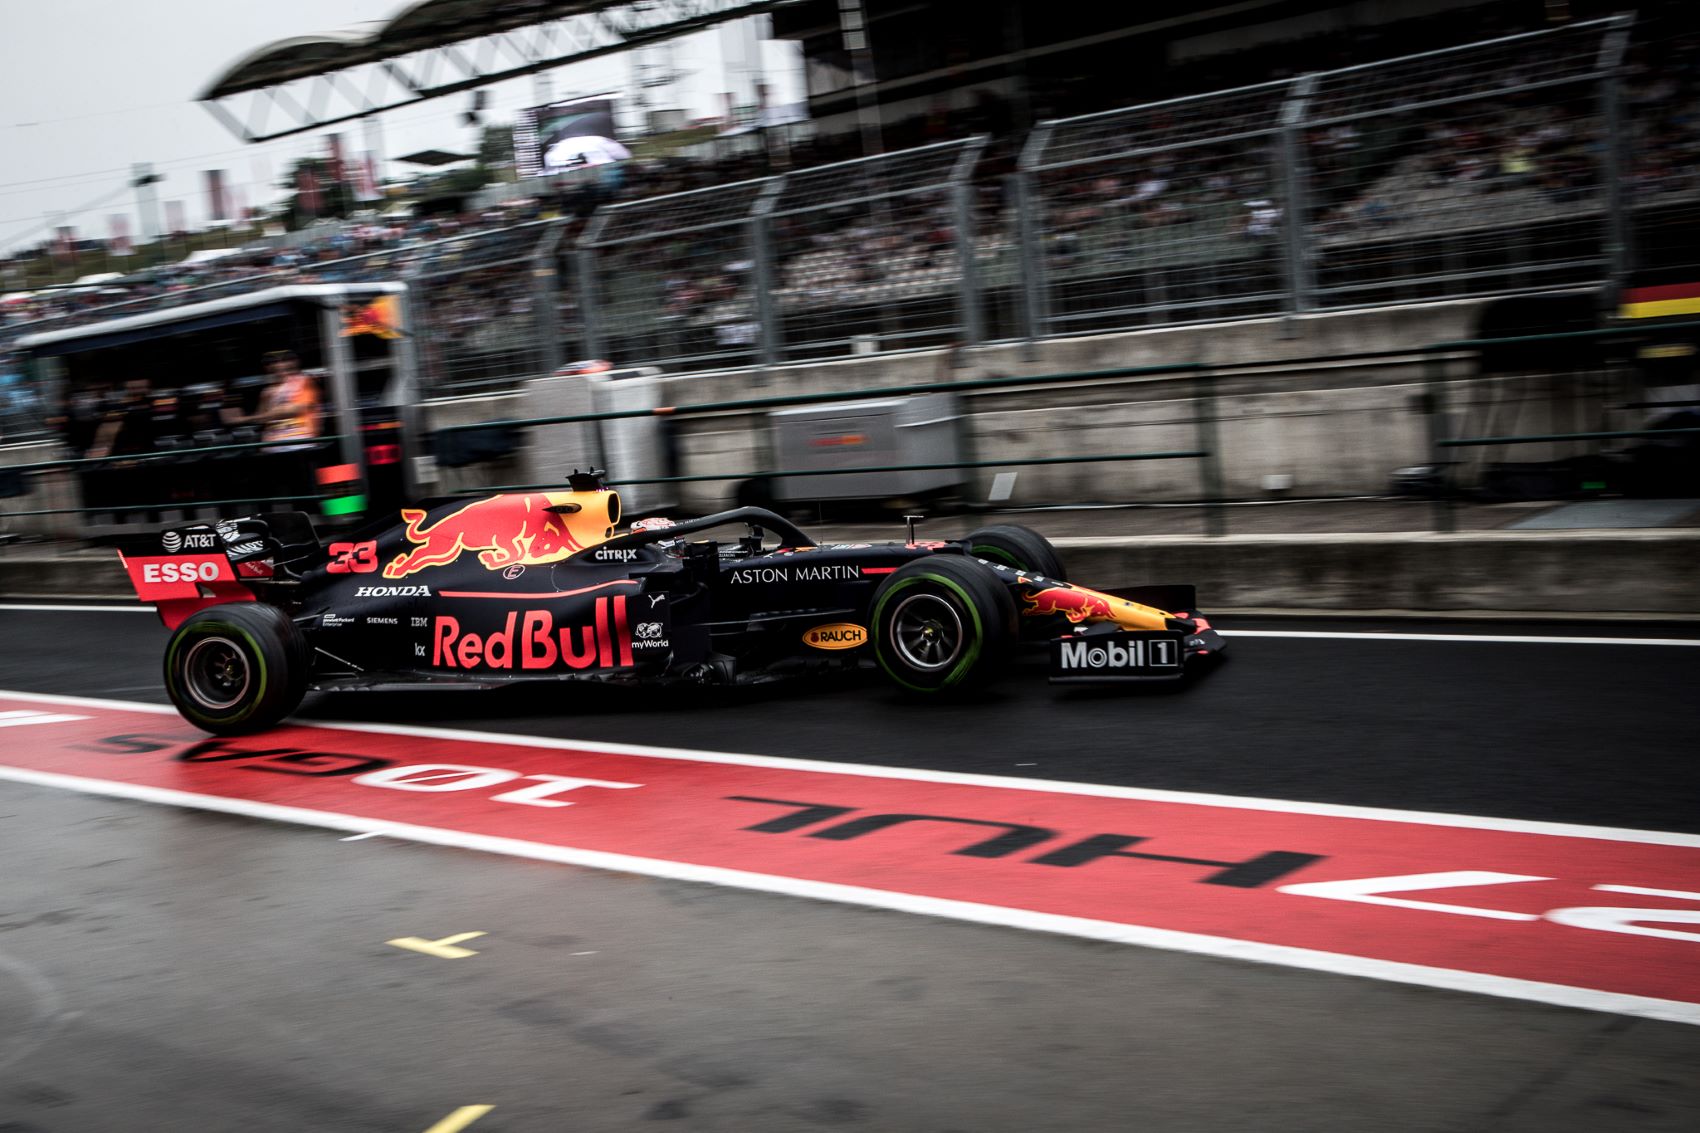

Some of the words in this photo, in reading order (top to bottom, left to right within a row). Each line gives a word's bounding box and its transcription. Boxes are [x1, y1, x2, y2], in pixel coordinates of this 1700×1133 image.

[183, 533, 217, 549] AT&T
[326, 540, 378, 573] 33
[143, 561, 219, 583] ESSO
[730, 568, 788, 584] ASTON
[795, 565, 860, 581] MARTIN
[354, 585, 432, 597] HONDA
[366, 617, 398, 625] SIEMENS
[410, 616, 429, 627] IBM
[432, 610, 517, 669] Red
[521, 595, 634, 669] Bull
[819, 629, 862, 644] RAUCH
[631, 639, 670, 650] myWorld
[1060, 640, 1145, 669] Mobil
